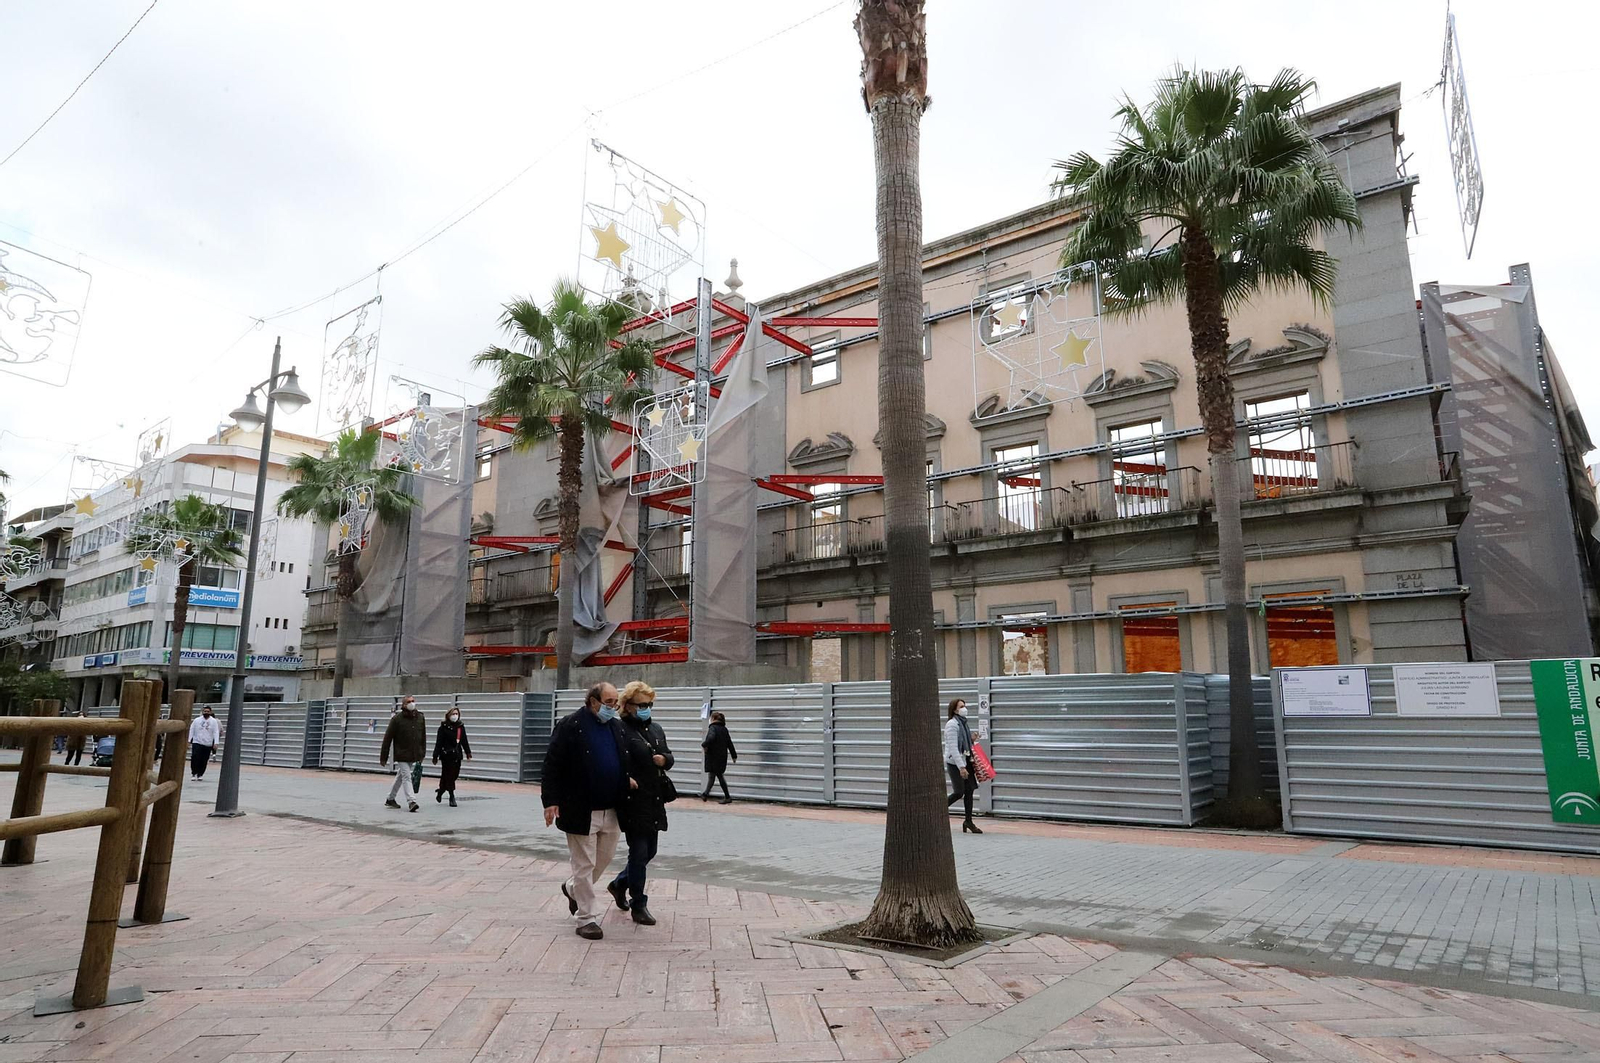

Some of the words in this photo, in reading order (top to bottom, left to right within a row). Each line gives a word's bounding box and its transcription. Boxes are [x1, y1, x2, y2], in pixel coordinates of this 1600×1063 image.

[1396, 572, 1423, 581] PLAZA
[180, 651, 235, 660] PREVENTIVA
[1564, 660, 1582, 710] ANDALUCIA
[1572, 714, 1585, 726] DE
[1574, 730, 1590, 760] JUNTA
